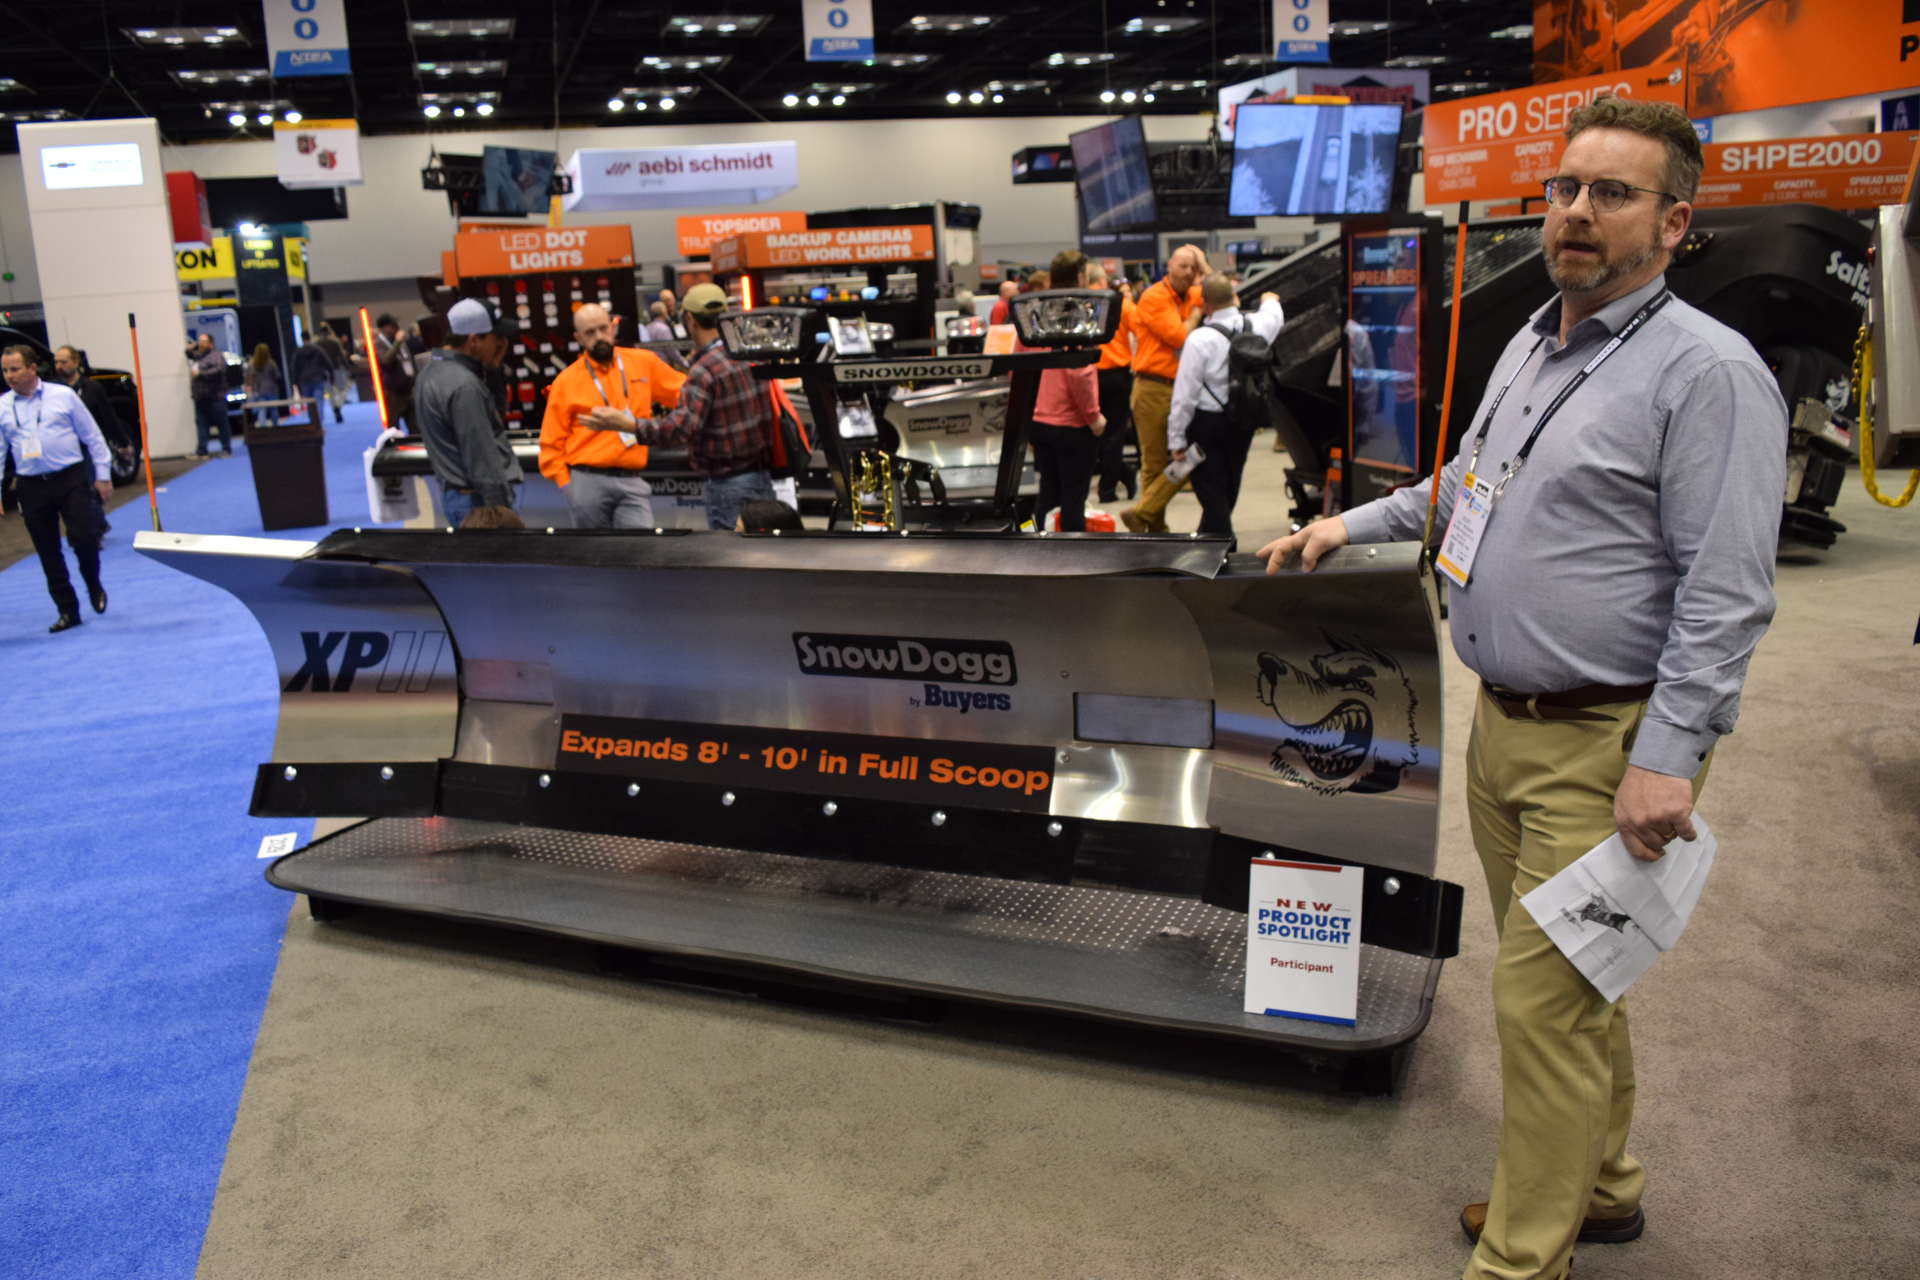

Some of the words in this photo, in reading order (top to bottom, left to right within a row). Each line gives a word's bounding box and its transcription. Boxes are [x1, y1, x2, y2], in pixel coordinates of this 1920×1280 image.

[1458, 101, 1518, 142] PRO
[638, 156, 684, 175] aebi
[689, 152, 773, 173] schmidt
[1721, 138, 1882, 172] SHPE2000
[1774, 179, 1816, 190] CAPACITY:
[1849, 175, 1884, 186] SPREAD
[703, 217, 781, 234] TOPSIDER
[501, 232, 540, 251] LED
[545, 230, 588, 248] DOT
[766, 232, 832, 248] BACKUP
[836, 228, 912, 245] CAMERAS
[510, 249, 584, 270] LIGHTS
[770, 250, 800, 264] LED
[803, 246, 852, 261] WORK
[856, 244, 911, 259] LIGHTS
[1352, 268, 1417, 287] SPREADERS
[843, 363, 982, 380] SNOWDOGG
[798, 635, 1012, 684] SnowDogg
[909, 696, 920, 707] by
[923, 684, 1011, 714] Buyers
[561, 730, 688, 762] Expands
[698, 741, 728, 763] 8'
[761, 746, 808, 770] 10'
[818, 749, 848, 774] in
[858, 753, 919, 780] Full
[929, 758, 1050, 796] Scoop
[1276, 898, 1333, 912] NEW
[1258, 908, 1352, 930] PRODUCT
[1257, 922, 1352, 944] SPOTLIGHT
[1270, 957, 1334, 974] Participant
